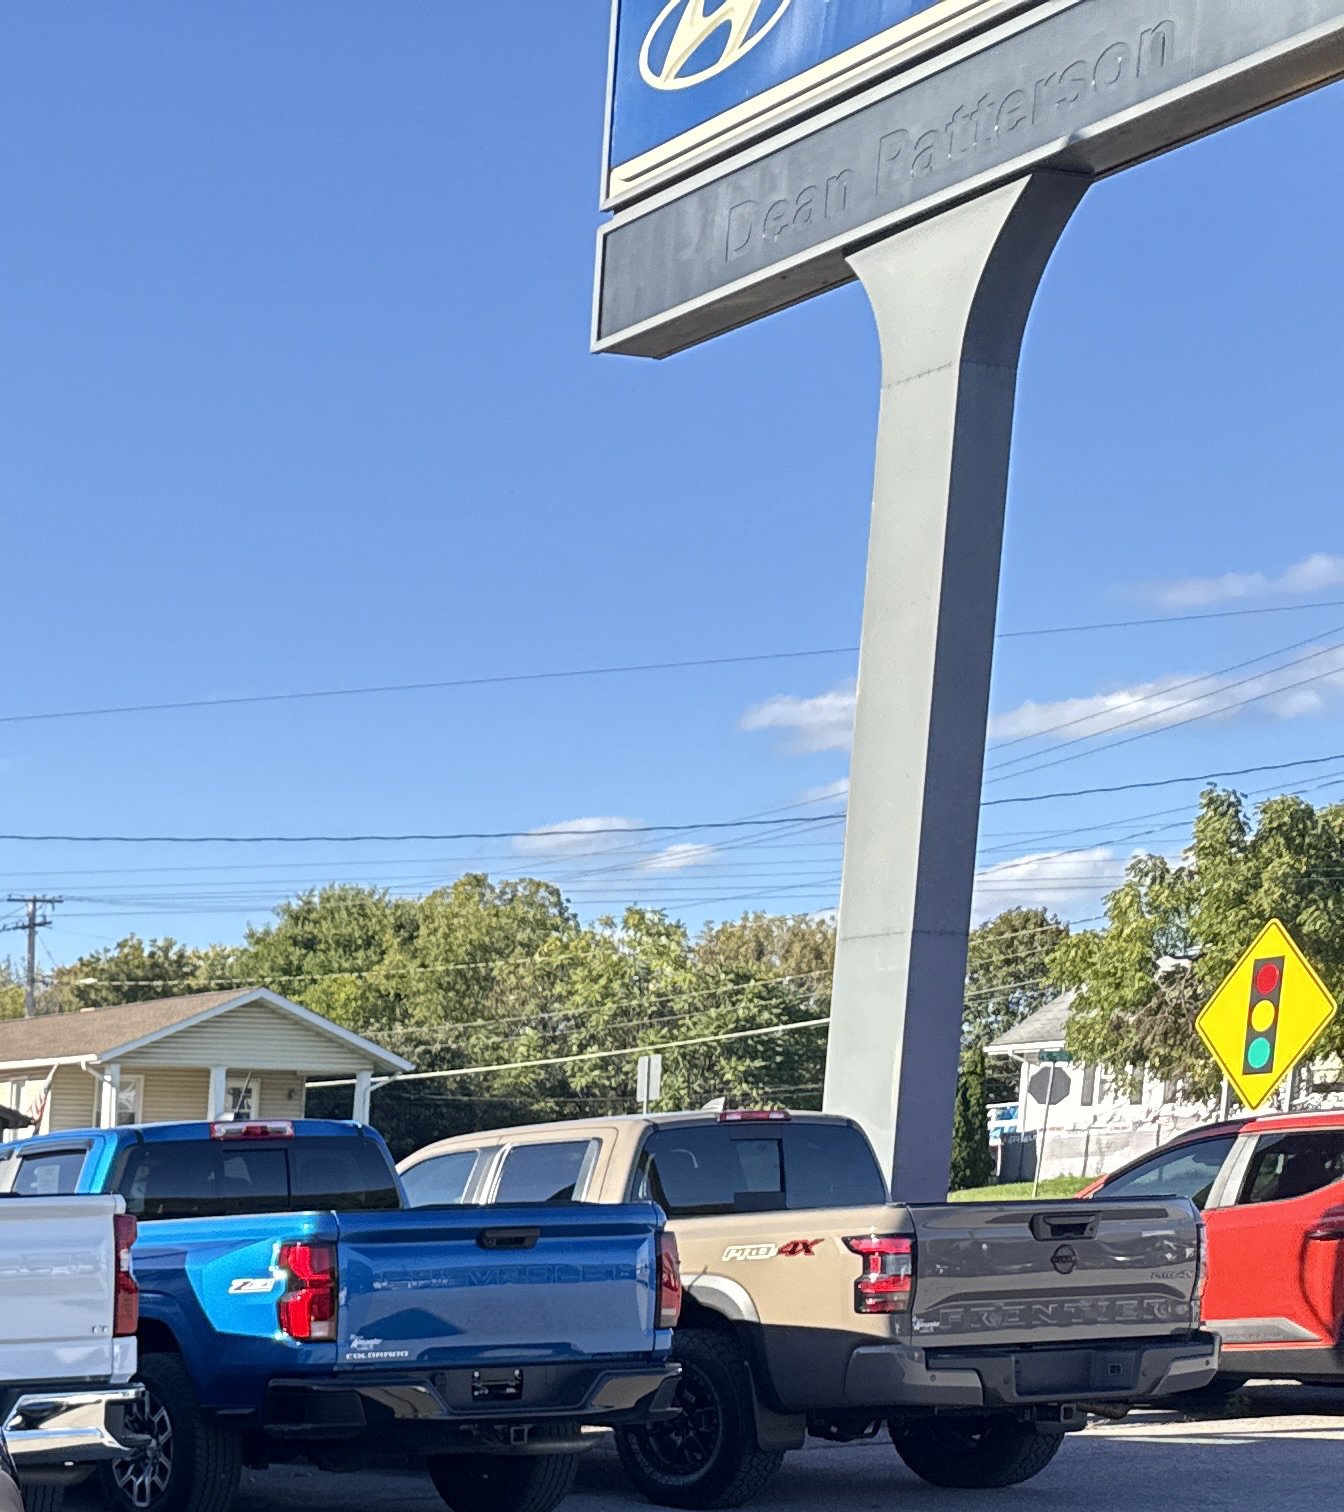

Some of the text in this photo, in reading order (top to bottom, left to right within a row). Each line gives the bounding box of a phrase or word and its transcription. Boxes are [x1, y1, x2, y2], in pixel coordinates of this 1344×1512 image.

[724, 17, 1177, 263] Dean Patterson
[938, 1297, 1170, 1330] FRONTIER
